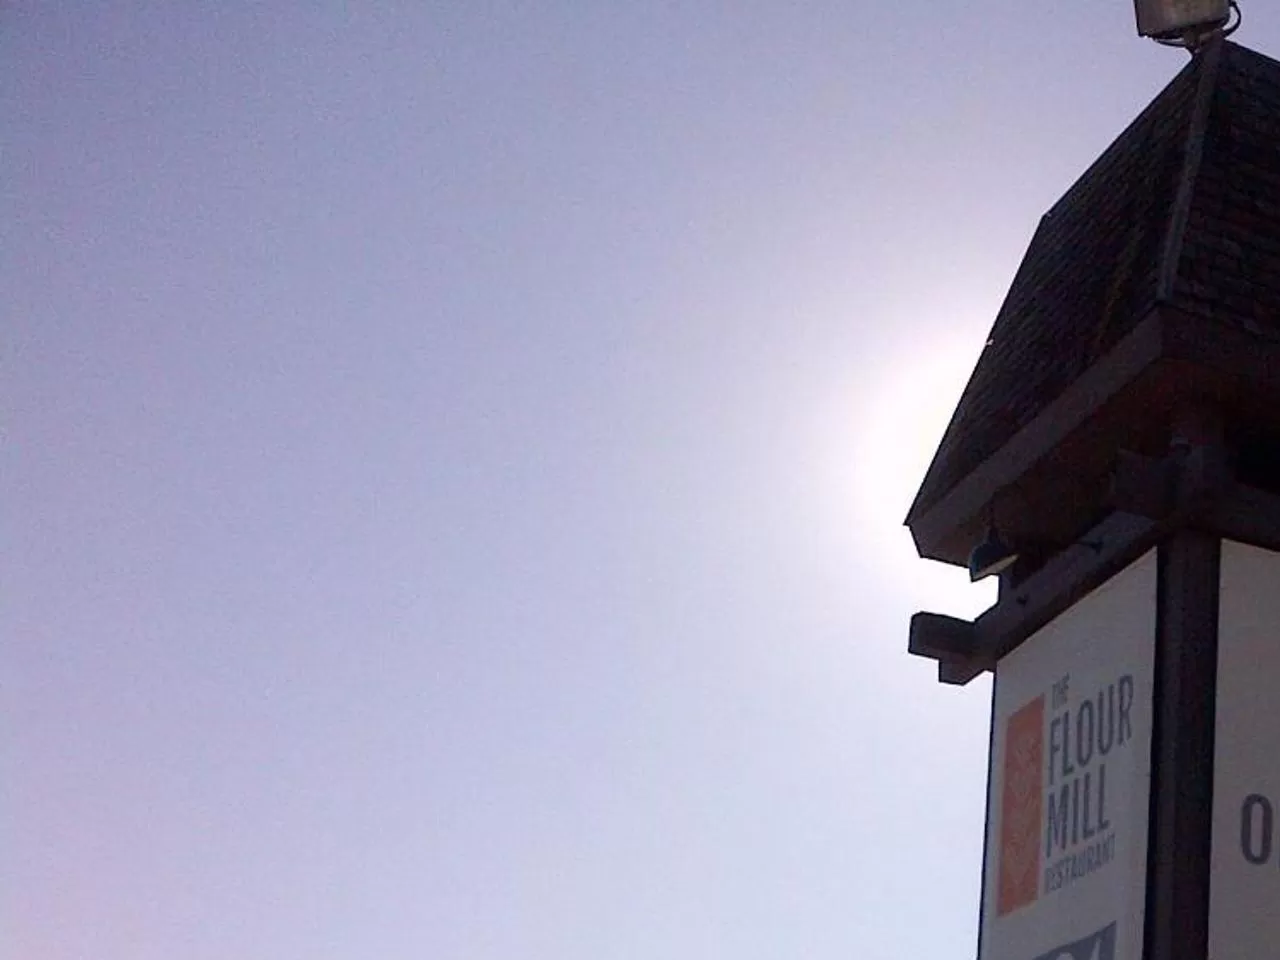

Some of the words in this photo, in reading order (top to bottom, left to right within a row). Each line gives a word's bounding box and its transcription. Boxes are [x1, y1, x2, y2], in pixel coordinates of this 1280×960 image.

[1049, 674, 1135, 786] FLOUR
[1052, 672, 1071, 712] THE
[1046, 763, 1110, 859] MILL
[1044, 832, 1116, 895] RESTAURANT
